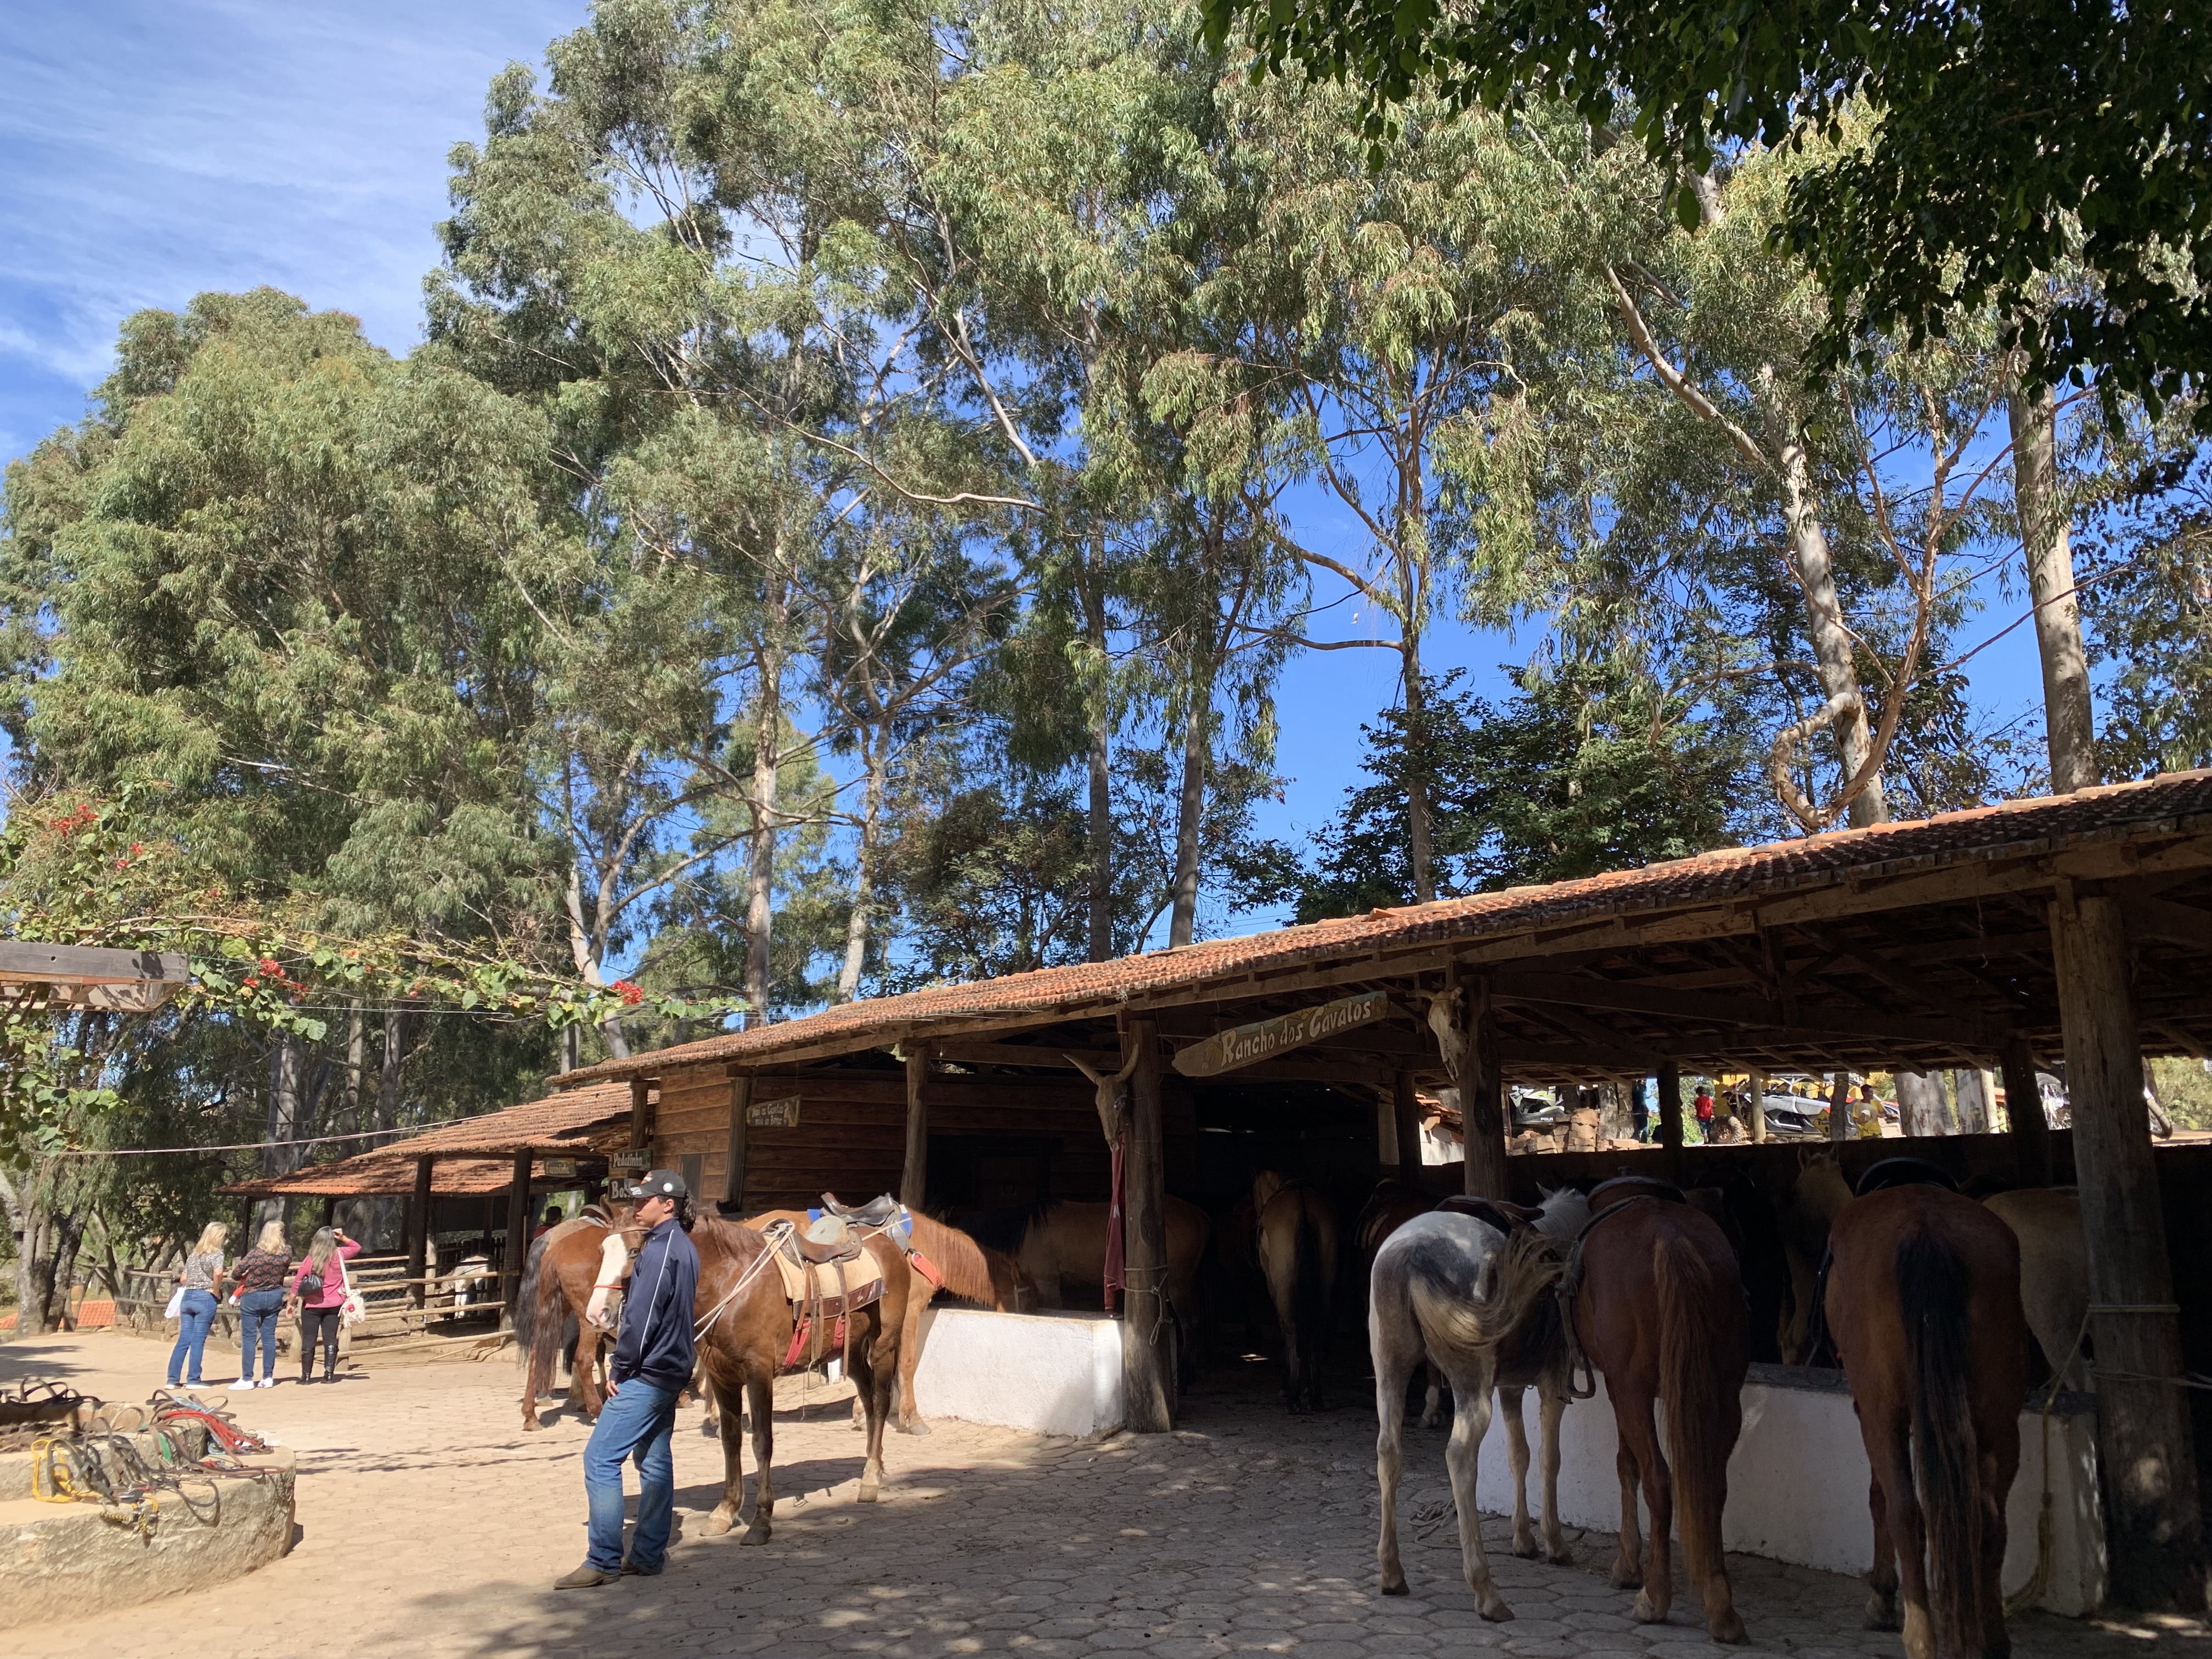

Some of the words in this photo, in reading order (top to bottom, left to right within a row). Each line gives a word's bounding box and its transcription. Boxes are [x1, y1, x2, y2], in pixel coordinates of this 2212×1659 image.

[1221, 1024, 1275, 1068] Rancho
[1280, 1019, 1304, 1045] dos
[1309, 1000, 1370, 1037] Cavalos
